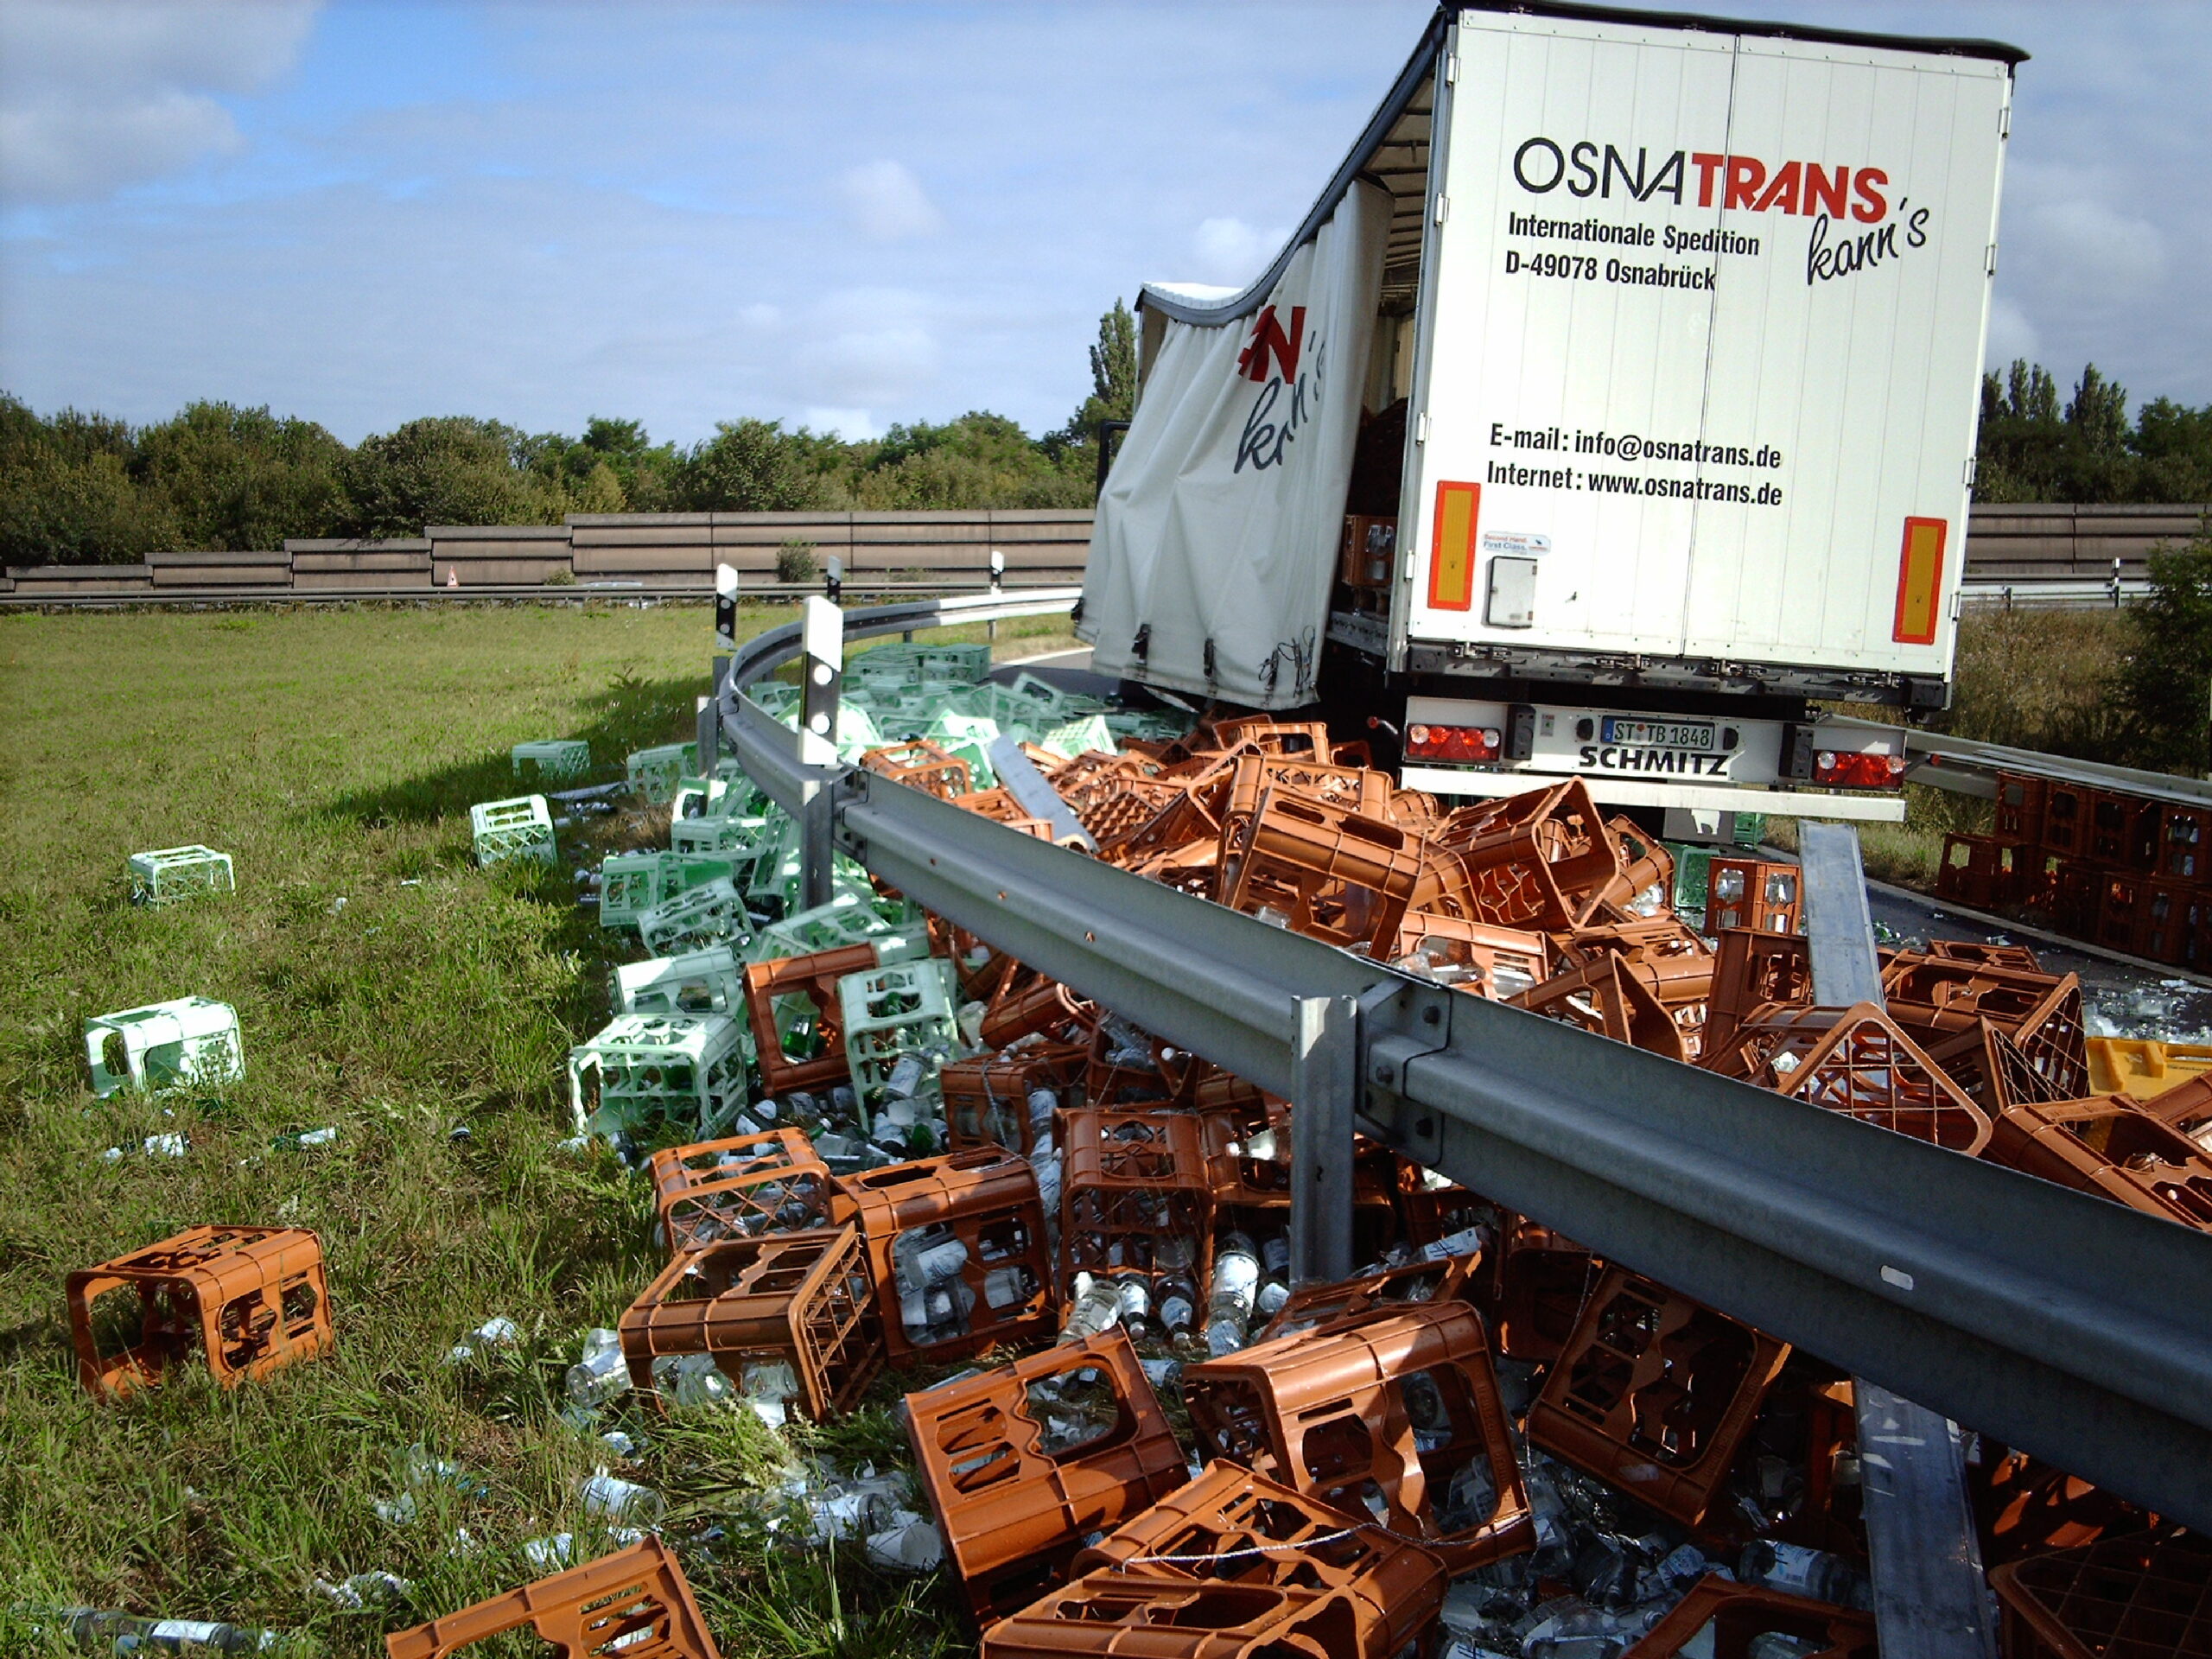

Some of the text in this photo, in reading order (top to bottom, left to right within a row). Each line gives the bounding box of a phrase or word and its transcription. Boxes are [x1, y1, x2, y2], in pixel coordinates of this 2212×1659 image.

[1513, 137, 1889, 224] OSNATRANS
[1508, 212, 1760, 256] Internationale Spedition
[1808, 197, 1929, 286] kann's
[1505, 250, 1717, 291] D-49078 Osnabrück
[1490, 423, 1782, 469] E-mail: info@osnatrans.de
[1486, 461, 1783, 506] Internet: www.osnatrans.de
[1614, 722, 1636, 741] ST
[1646, 724, 1666, 743] TB
[1669, 727, 1710, 747] 1848
[1579, 746, 1730, 776] SCHMITZ
